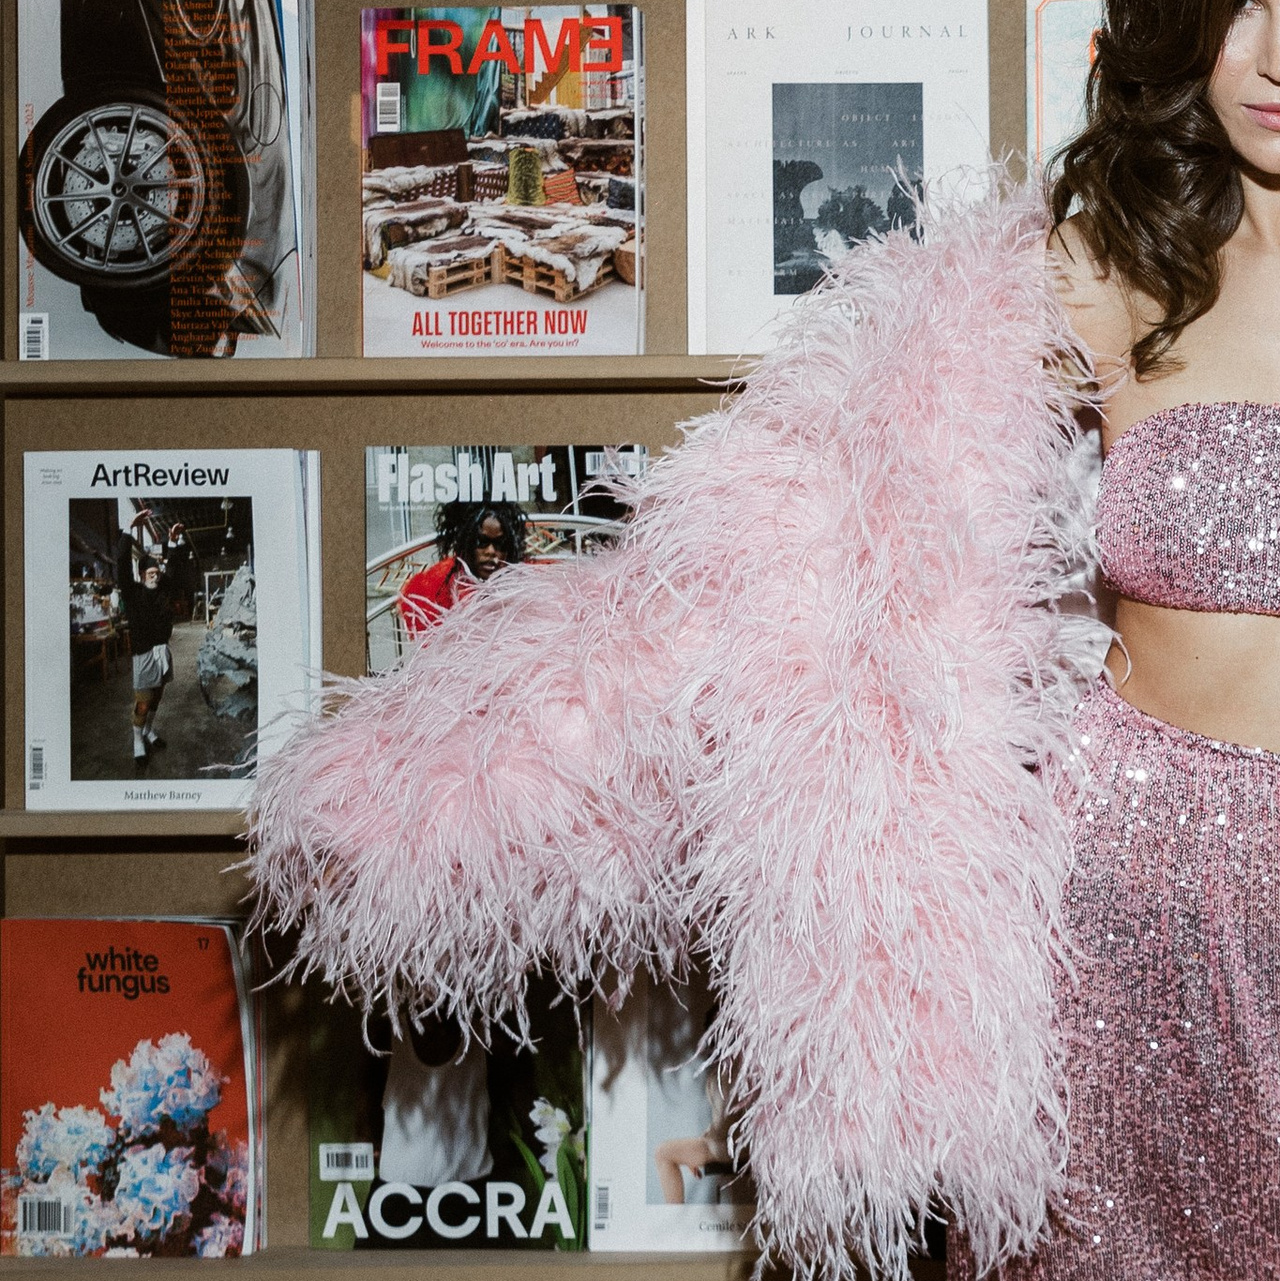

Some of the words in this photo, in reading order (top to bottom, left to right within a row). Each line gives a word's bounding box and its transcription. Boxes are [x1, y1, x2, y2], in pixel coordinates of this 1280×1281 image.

[184, 0, 214, 10] Ahmed
[727, 26, 777, 41] ARK
[846, 24, 968, 42] JOURNAL
[841, 114, 891, 122] OBJECT
[170, 286, 189, 294] Ana
[170, 298, 202, 306] Emilia
[412, 312, 443, 336] ALL
[449, 310, 539, 336] TOGETHER
[544, 310, 588, 334] NOW
[421, 339, 464, 348] Welcome
[465, 340, 475, 348] to
[476, 339, 491, 348] the
[529, 338, 547, 348] Are
[548, 340, 564, 349] you
[565, 338, 579, 347] in?
[90, 462, 230, 488] ArtReview
[378, 452, 484, 503] Flash
[491, 452, 558, 503] Art
[124, 790, 167, 801] Matthew
[169, 790, 202, 803] Barney
[86, 946, 159, 972] white
[77, 966, 171, 1001] fungus
[322, 1182, 576, 1240] ACCRA
